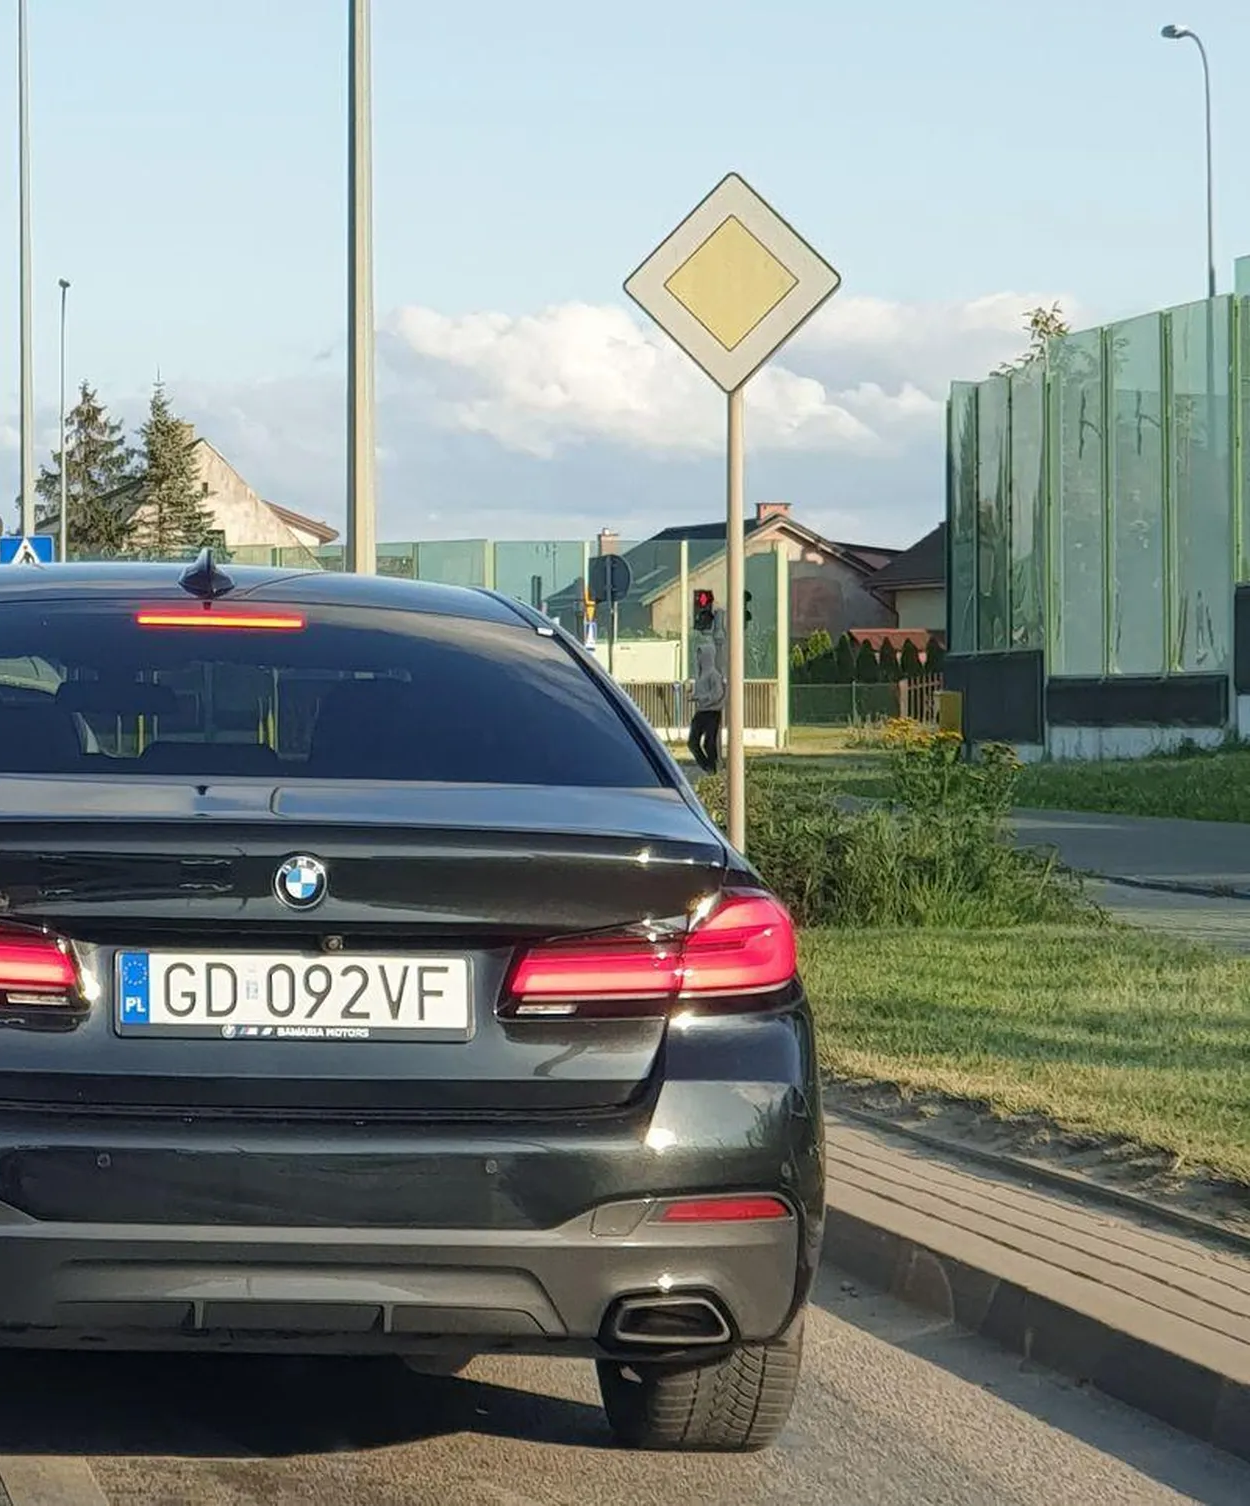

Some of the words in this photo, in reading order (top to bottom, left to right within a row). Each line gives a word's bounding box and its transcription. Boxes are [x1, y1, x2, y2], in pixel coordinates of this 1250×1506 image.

[163, 962, 238, 1018] GD
[265, 963, 449, 1021] 092VF
[125, 998, 147, 1013] PL
[326, 1028, 370, 1038] MOTORS
